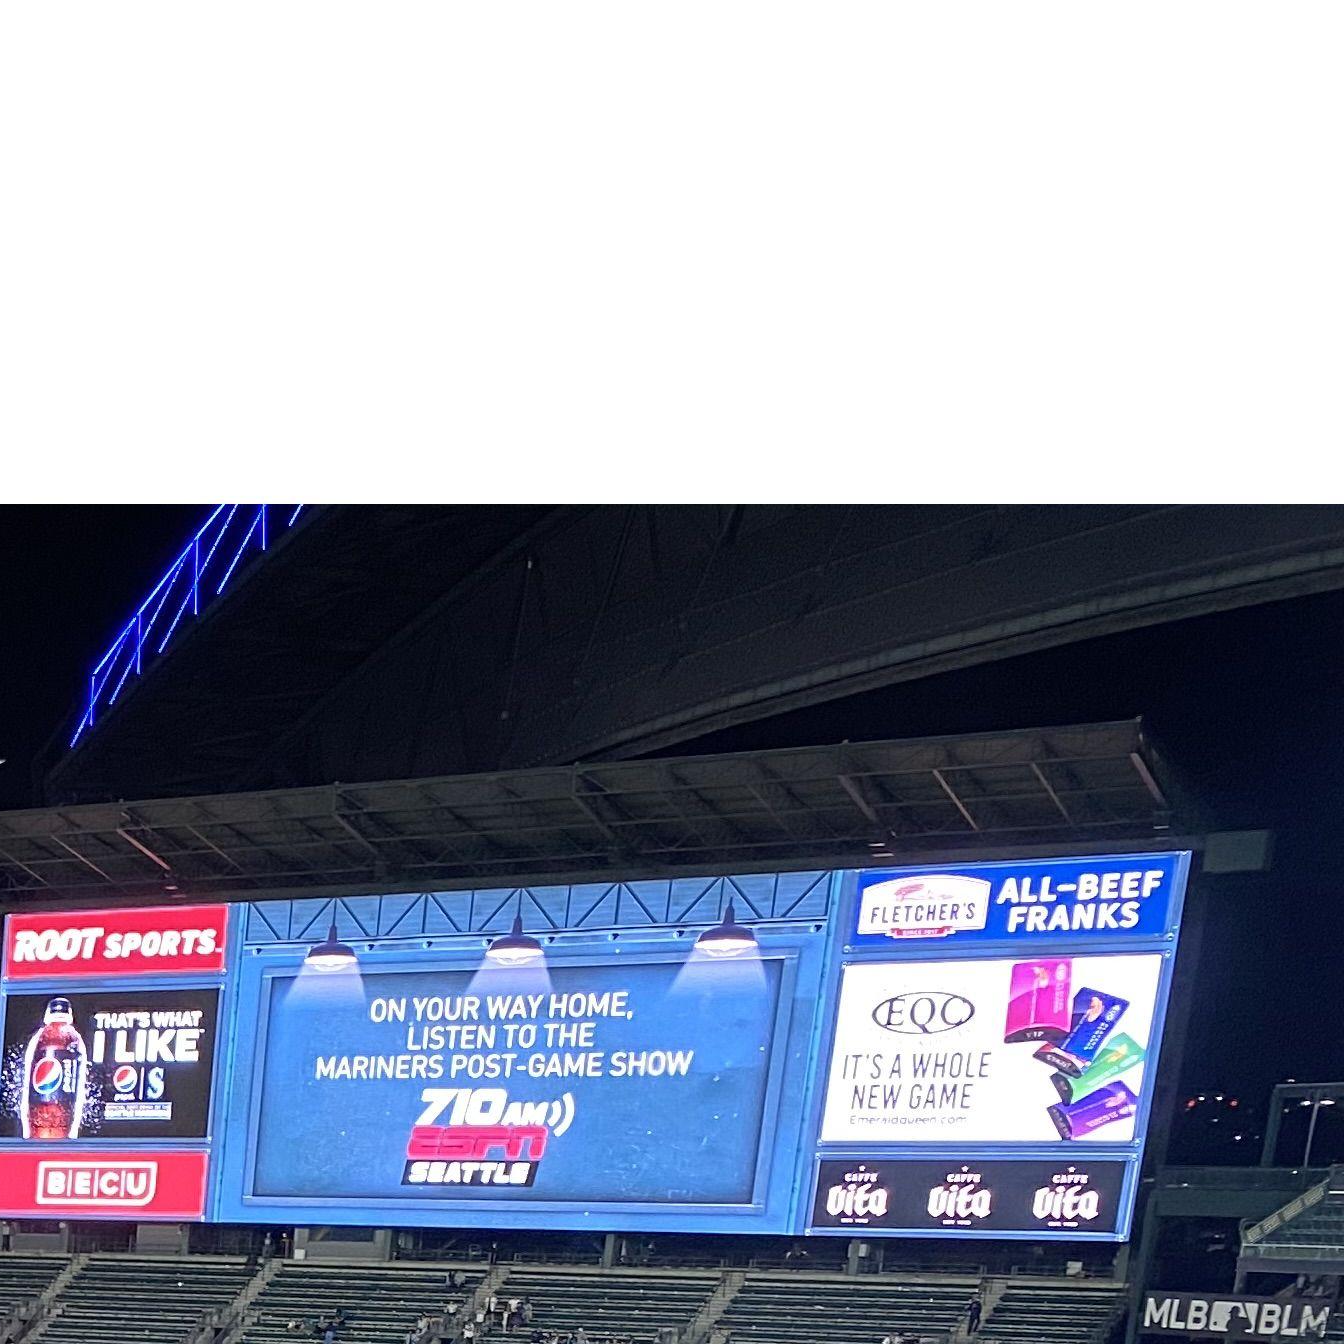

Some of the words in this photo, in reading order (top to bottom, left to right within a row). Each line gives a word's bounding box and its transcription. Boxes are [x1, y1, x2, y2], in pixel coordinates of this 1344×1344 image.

[996, 870, 1164, 904] ALL-BEEF
[870, 903, 976, 924] FLETCHER'S
[1006, 901, 1141, 932] FRANKS
[13, 927, 104, 962] ROOT
[104, 928, 216, 959] SPORTS
[93, 1012, 151, 1028] THAT'S
[152, 1010, 203, 1028] WHAT
[370, 998, 406, 1023] ON
[412, 995, 480, 1021] YOUR
[486, 994, 544, 1019] WAY
[547, 991, 633, 1020] HOME,
[92, 1030, 105, 1063] I
[115, 1028, 200, 1062] LIKE
[407, 1024, 496, 1050] LISTEN
[503, 1023, 537, 1049] TO
[543, 1022, 596, 1047] THE
[315, 1054, 444, 1080] MARINERS
[450, 1052, 604, 1078] POST-GAME
[609, 1050, 694, 1077] SHOW
[842, 1053, 883, 1079] IT'S
[888, 1054, 902, 1079] A
[911, 1052, 992, 1078] WHOLE
[850, 1085, 902, 1110] NEW
[908, 1083, 973, 1110] GAME
[407, 1126, 548, 1160] ESPN
[408, 1162, 531, 1186] SEATTLE
[1144, 1297, 1209, 1330] MLB
[1258, 1303, 1330, 1338] BLM
